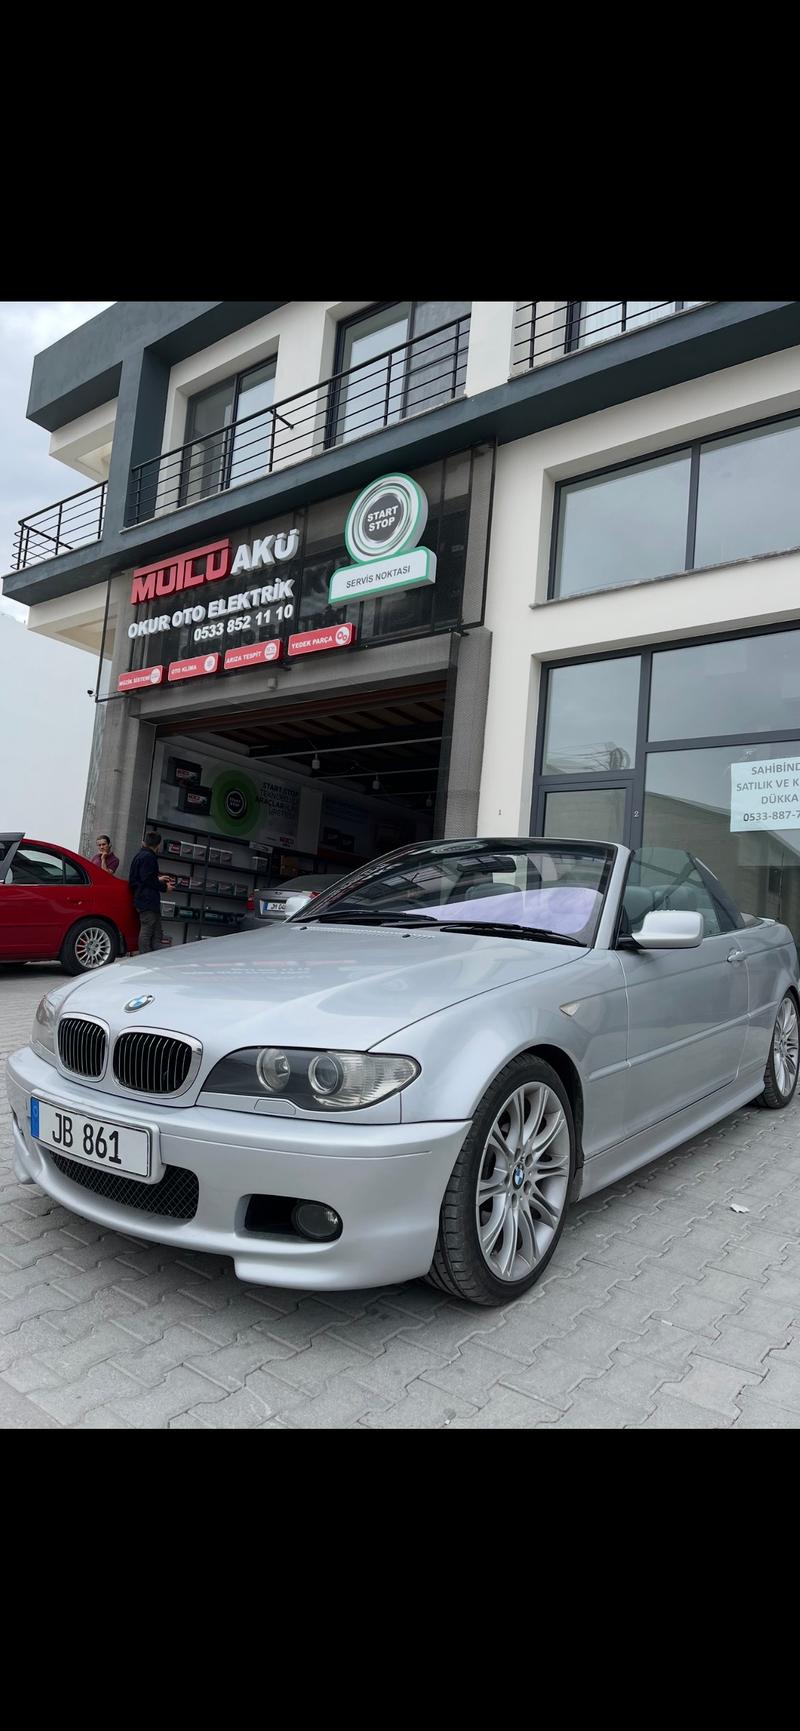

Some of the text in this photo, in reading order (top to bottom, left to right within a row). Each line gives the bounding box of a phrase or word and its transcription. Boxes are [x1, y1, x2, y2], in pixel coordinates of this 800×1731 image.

[367, 505, 399, 522] START
[368, 516, 396, 532] STOP
[131, 528, 300, 605] MUTLU AKÜ
[346, 565, 411, 588] SERVİS NOKTASI
[127, 577, 296, 639] OKUR OTO ELEKTRİK
[193, 603, 294, 642] 0533 852 11 10
[291, 635, 333, 649] YEDEK PARÇA
[736, 780, 773, 791] SATILIK
[776, 778, 789, 788] VE
[761, 793, 799, 804] DÜKKA
[52, 1112, 122, 1165] JB 861
